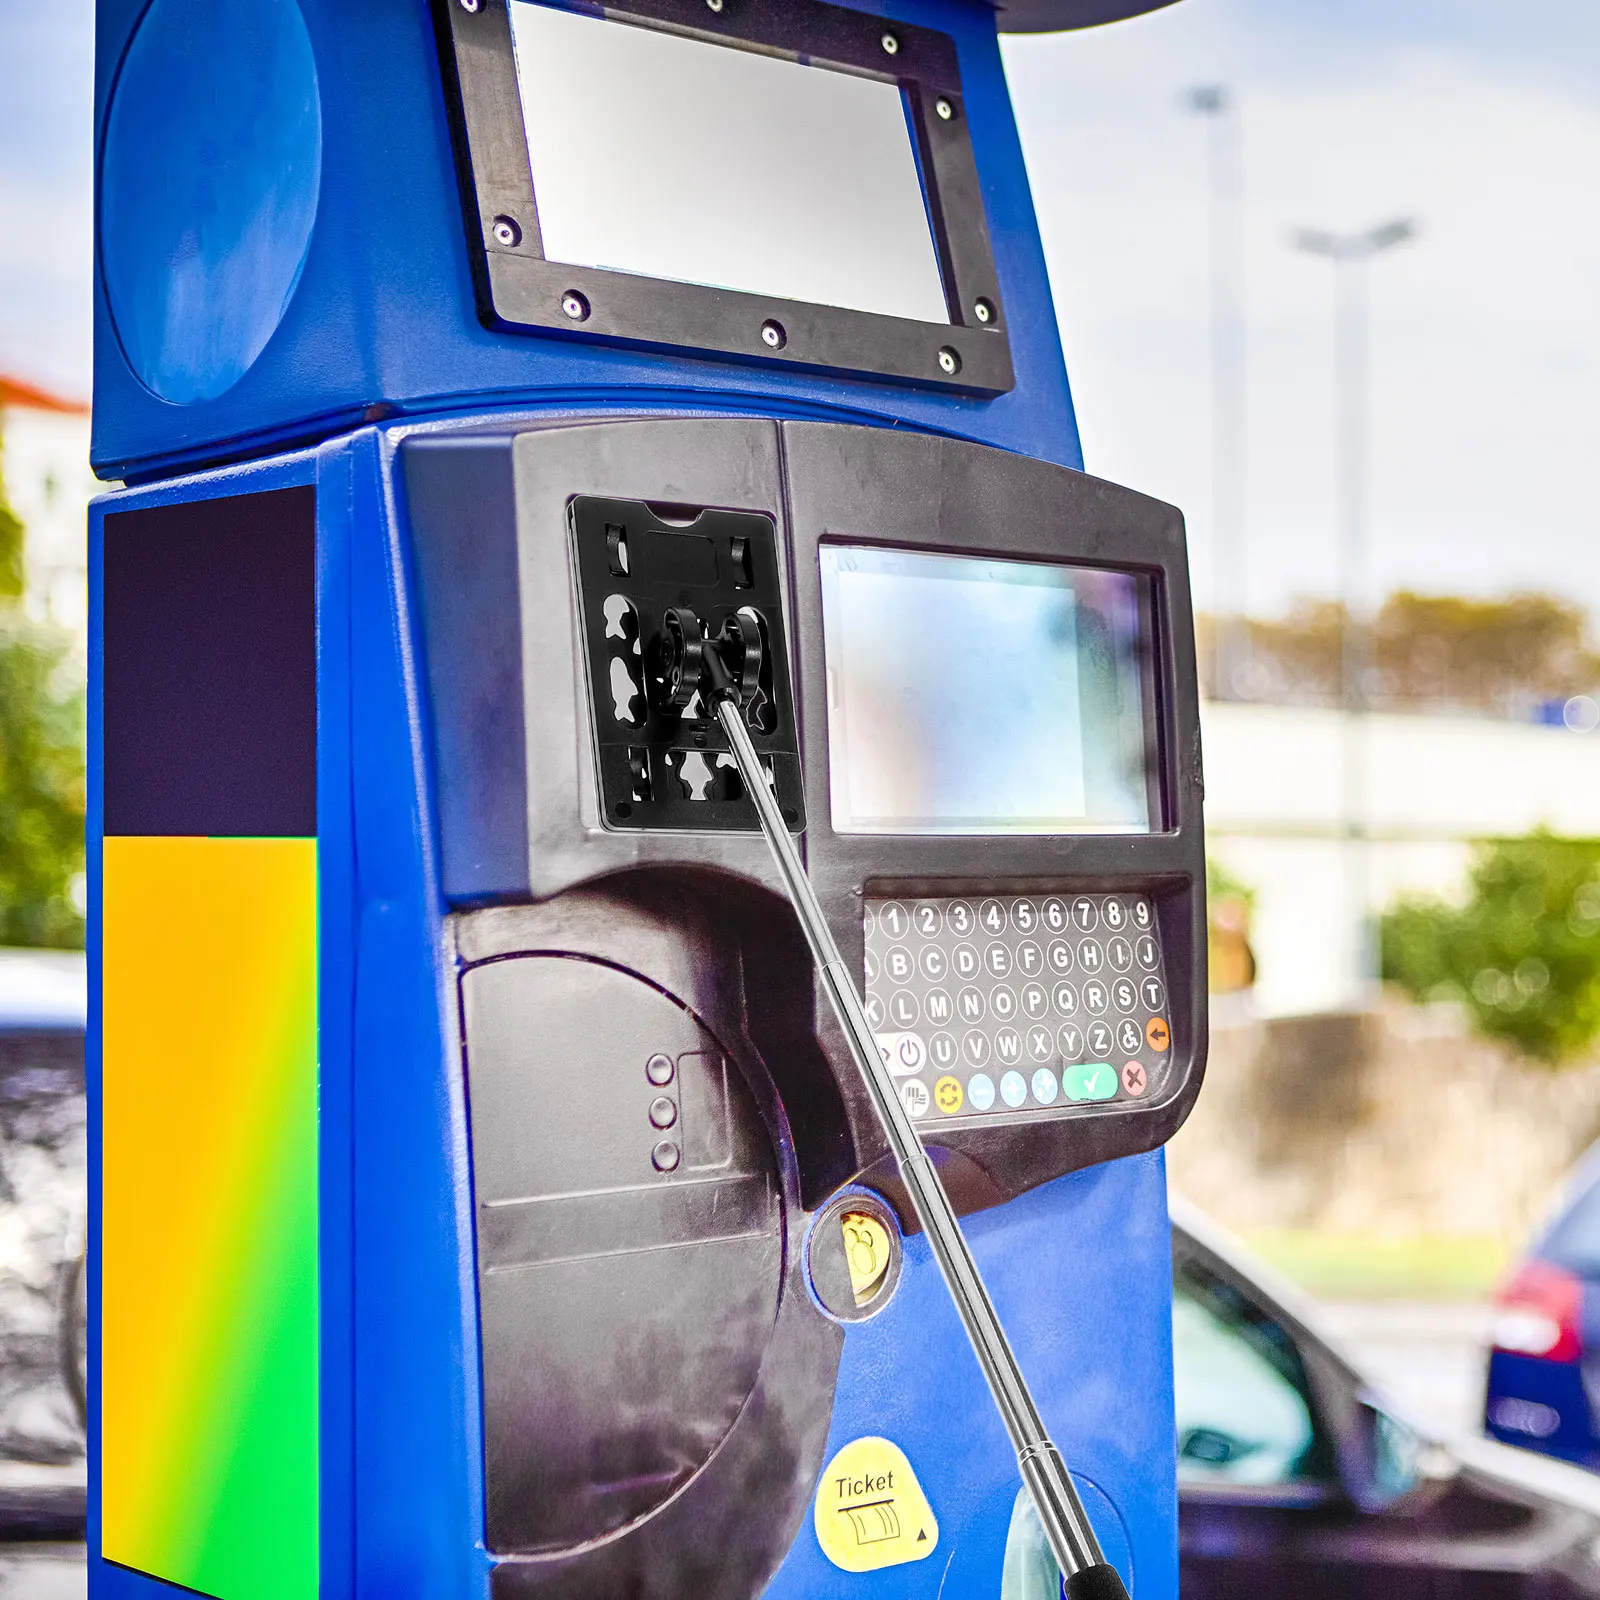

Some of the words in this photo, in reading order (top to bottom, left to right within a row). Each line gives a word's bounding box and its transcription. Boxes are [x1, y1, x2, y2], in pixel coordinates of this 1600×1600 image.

[888, 909, 899, 933] 1
[921, 908, 936, 932] 2
[955, 907, 968, 930] 3
[987, 906, 1000, 929] 4
[1019, 905, 1031, 928] 5
[1049, 904, 1062, 927] 6
[1078, 903, 1089, 926] 7
[1108, 902, 1121, 925] 8
[1136, 902, 1148, 924] 9
[892, 954, 907, 975] B
[927, 953, 940, 973] C
[959, 952, 973, 971] D
[992, 950, 1005, 970] E
[1024, 949, 1035, 968] F
[1054, 947, 1067, 967] G
[1084, 946, 1097, 965] H
[1117, 945, 1123, 964] I
[1143, 944, 1152, 963] J
[865, 1000, 879, 1022] K
[899, 999, 912, 1019] L
[930, 997, 947, 1017] M
[964, 995, 978, 1015] N
[996, 993, 1011, 1013] O
[1029, 991, 1041, 1011] P
[1059, 989, 1073, 1010] Q
[1089, 988, 1103, 1007] R
[1119, 986, 1131, 1005] S
[1147, 984, 1158, 1003] T
[936, 1040, 950, 1061] U
[969, 1038, 982, 1058] V
[999, 1036, 1017, 1056] W
[1033, 1034, 1047, 1054] X
[1063, 1031, 1075, 1051] Y
[1094, 1029, 1107, 1049] Z
[835, 1470, 894, 1498] Ticket
